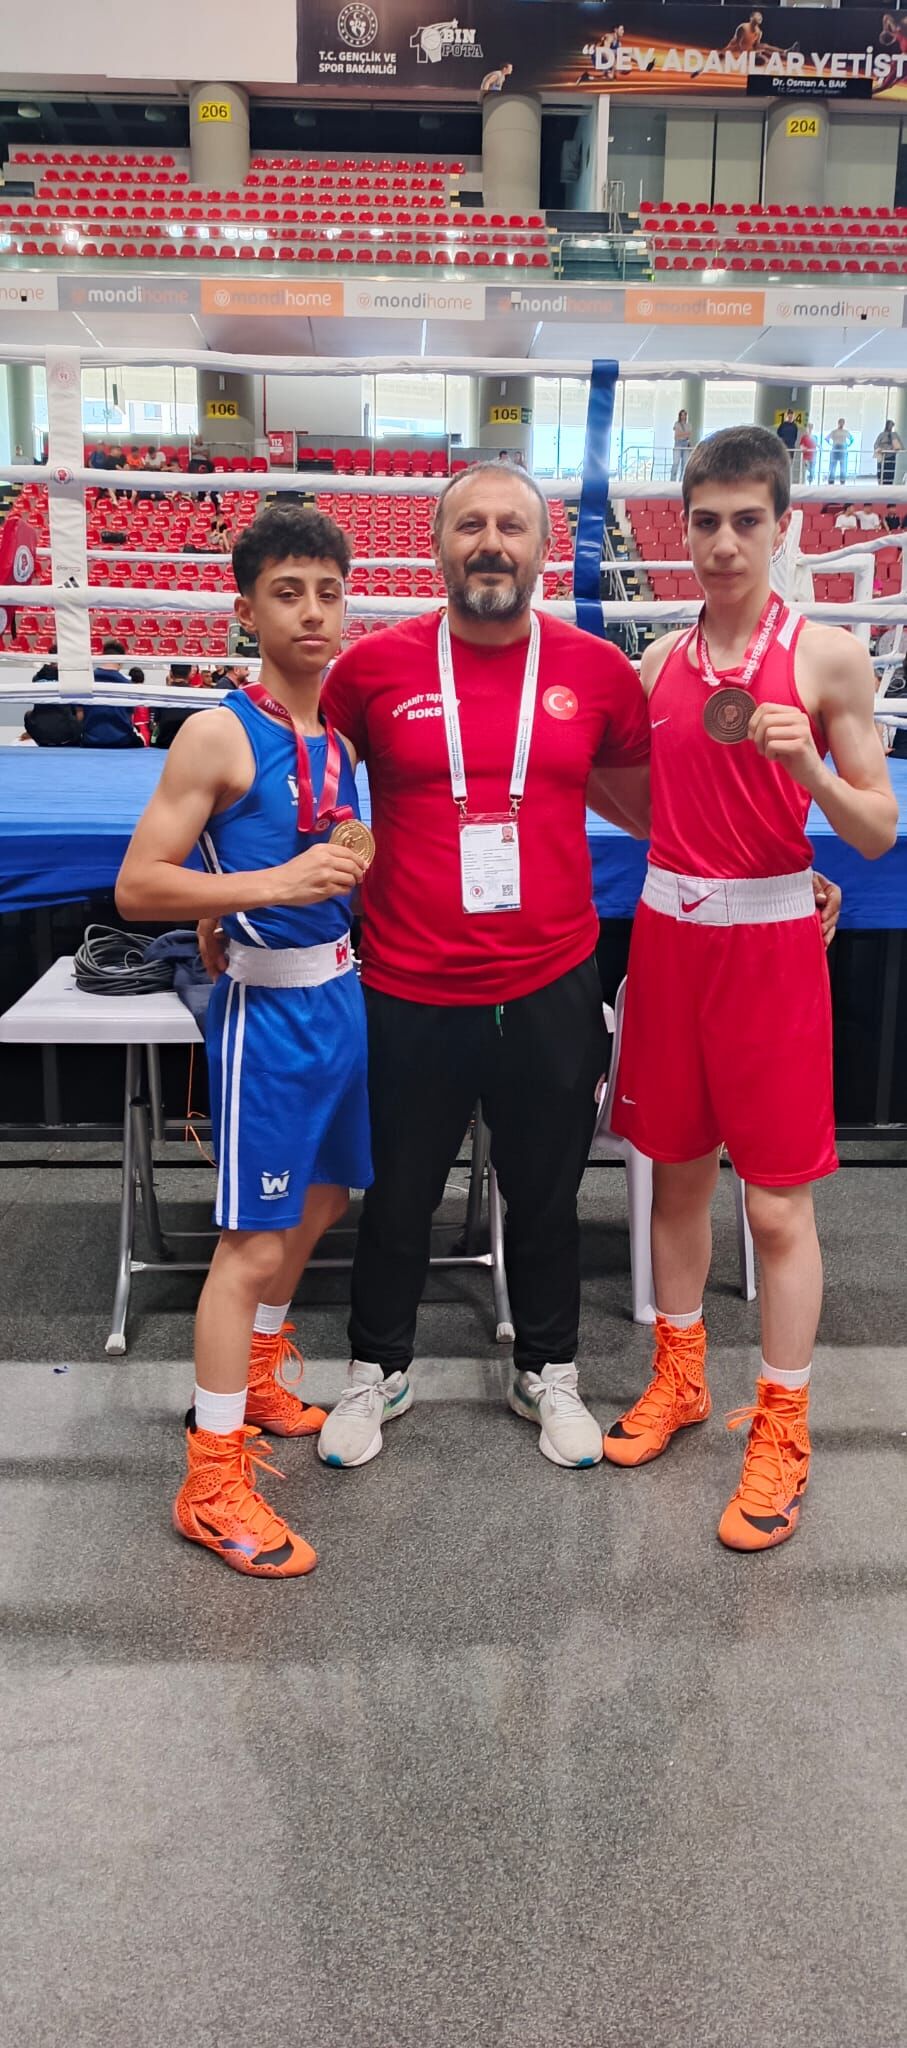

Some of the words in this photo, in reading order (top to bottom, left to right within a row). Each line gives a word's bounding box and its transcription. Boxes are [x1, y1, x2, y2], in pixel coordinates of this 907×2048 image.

[443, 29, 476, 44] BIN
[319, 51, 336, 60] T.C.
[339, 51, 381, 63] GENÇLİK
[384, 53, 396, 62] VE
[441, 44, 484, 57] POTA
[662, 48, 805, 77] ADAMLAR
[319, 64, 343, 73] SPOR
[346, 64, 396, 75] BAKANLIĞI
[772, 78, 785, 86] Dr.
[787, 79, 816, 87] Osman
[828, 80, 847, 88] BAK
[201, 105, 228, 118] 206
[790, 120, 816, 133] 204
[88, 286, 189, 304] mondihome
[374, 292, 472, 310] mondihome
[793, 300, 890, 318] mondihome
[210, 403, 236, 416] 106
[493, 408, 518, 420] 105
[778, 412, 802, 424] 14
[407, 706, 443, 720] BOKS
